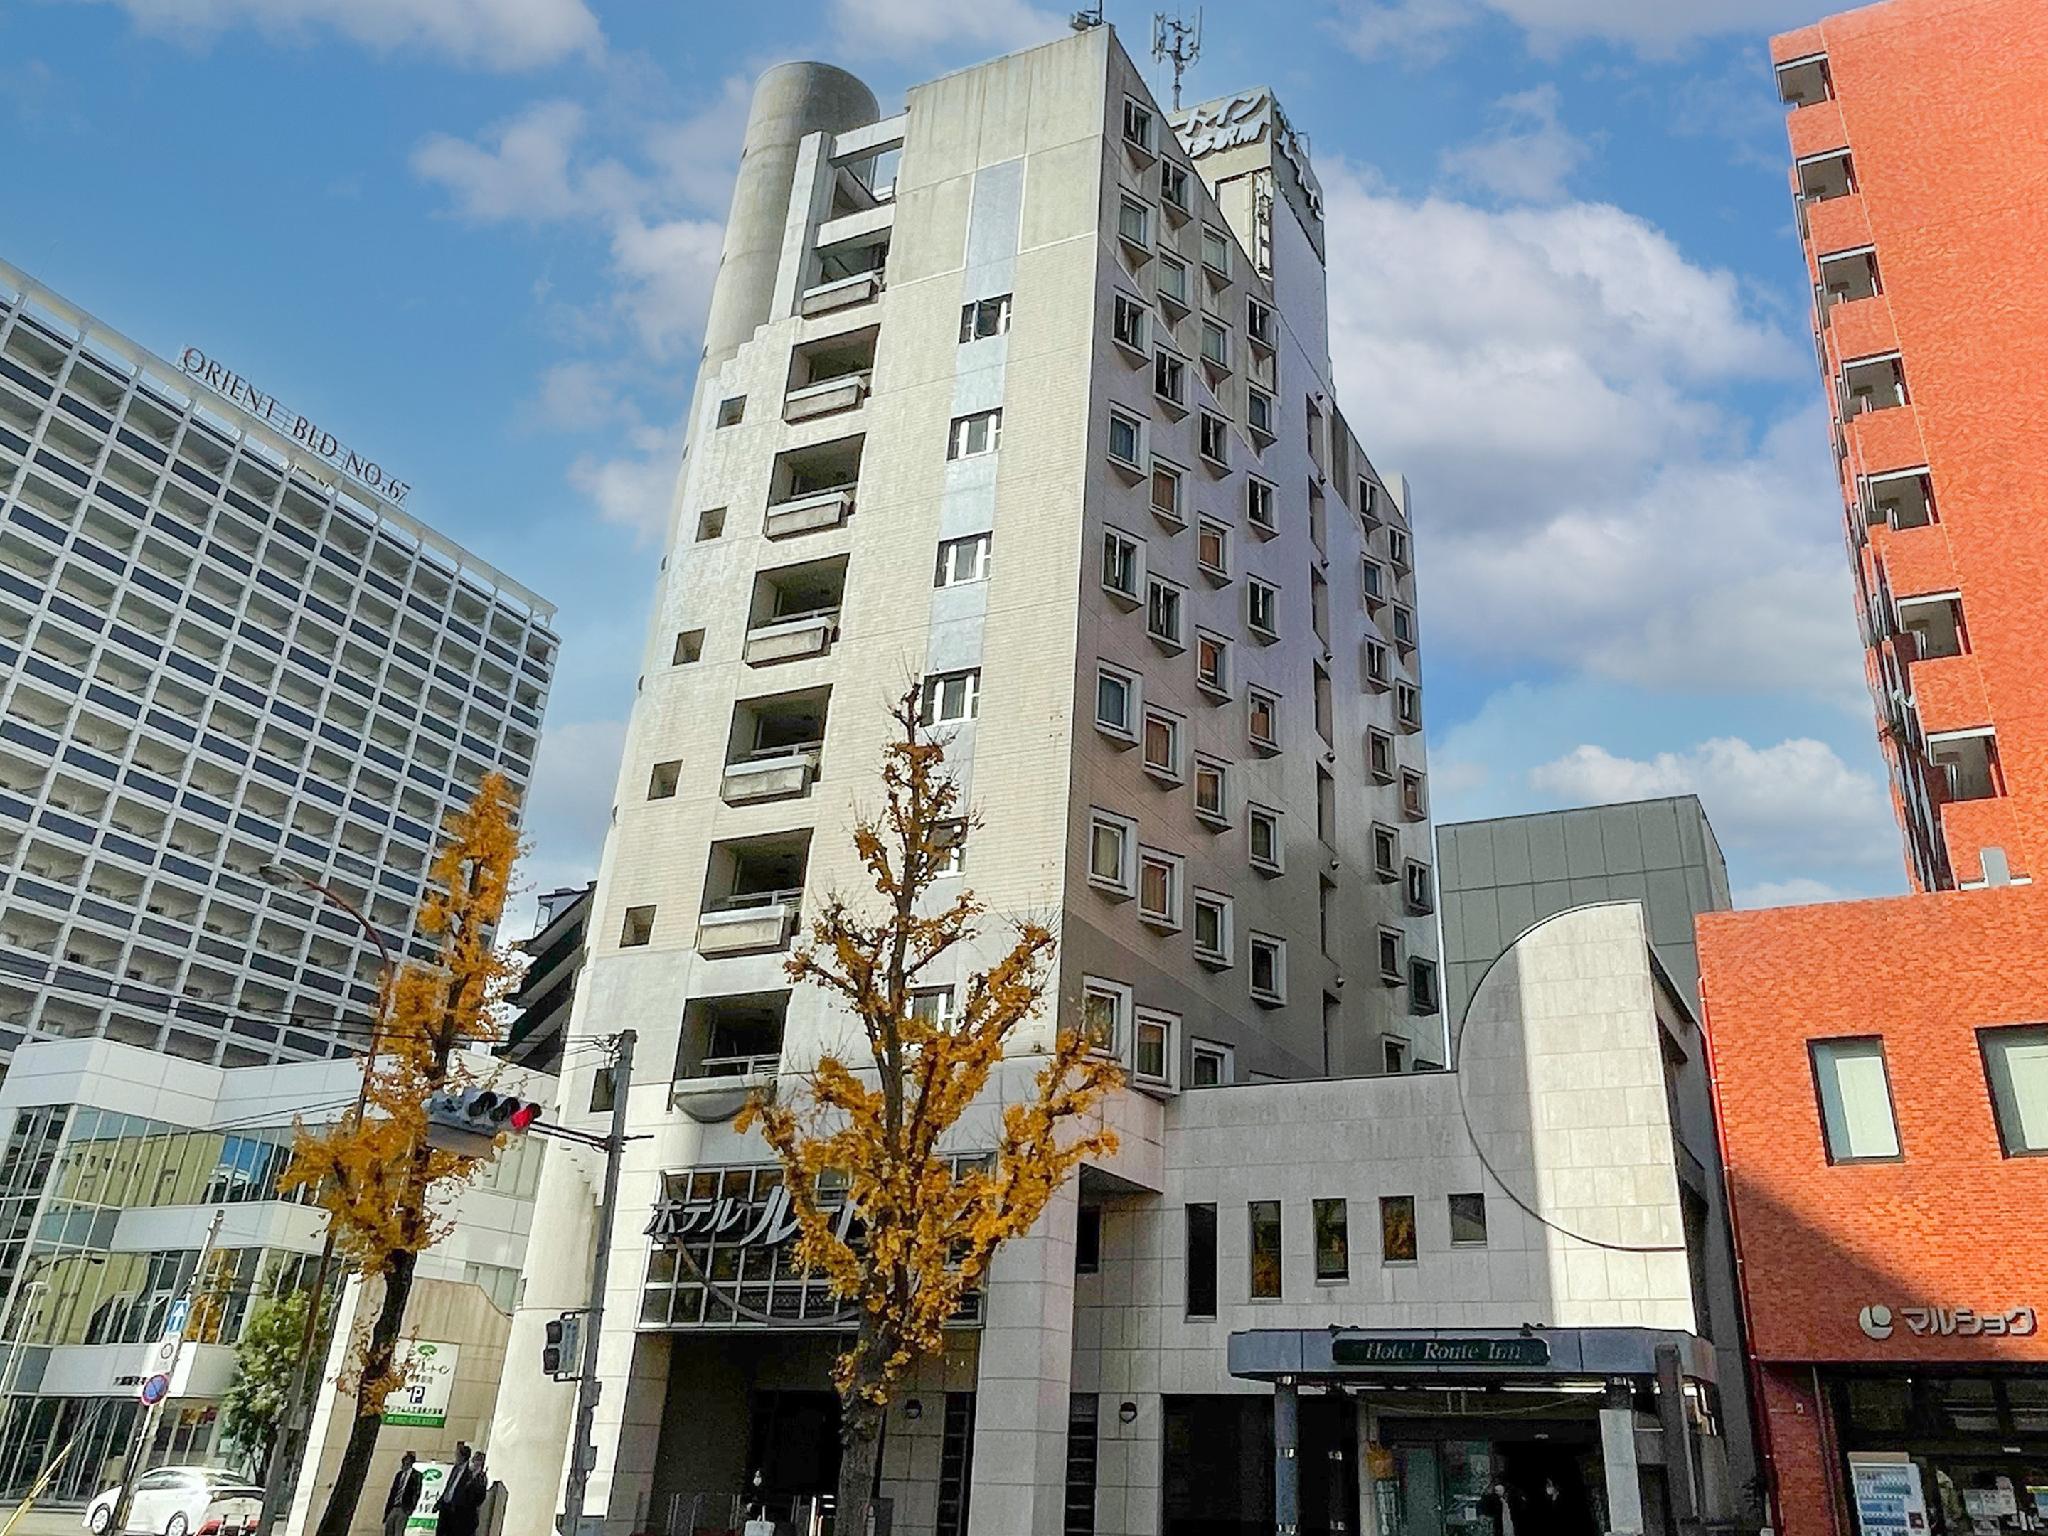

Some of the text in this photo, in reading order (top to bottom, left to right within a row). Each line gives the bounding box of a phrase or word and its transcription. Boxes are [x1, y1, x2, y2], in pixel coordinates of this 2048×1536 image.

[183, 347, 411, 501] ORIENT BLD NO.67
[1900, 1306, 2038, 1336] マルショク
[1366, 1342, 1521, 1360] Hotel Route Inn
